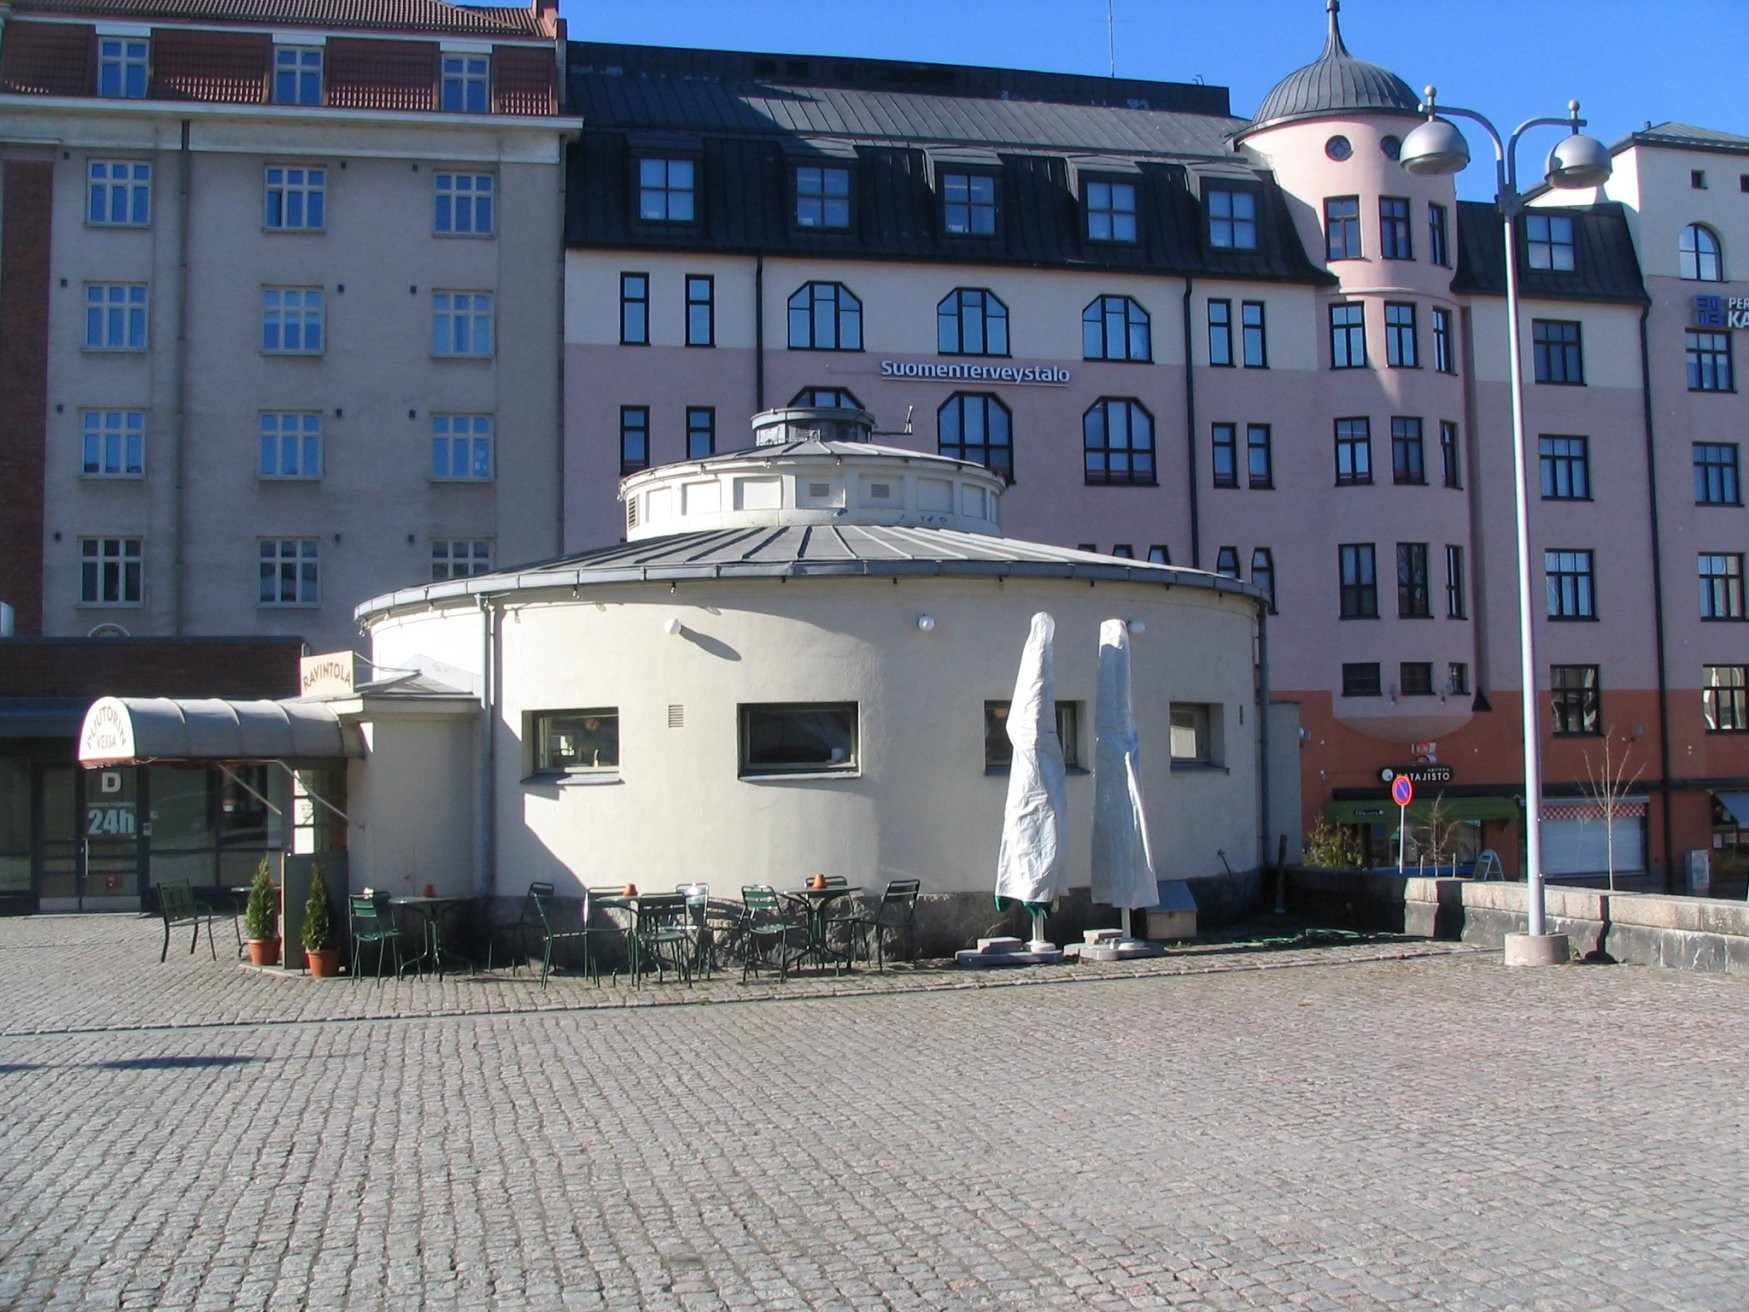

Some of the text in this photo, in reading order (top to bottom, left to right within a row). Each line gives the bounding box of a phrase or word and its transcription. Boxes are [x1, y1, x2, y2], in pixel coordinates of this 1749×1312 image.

[302, 662, 351, 691] RAVINTOLA
[96, 733, 117, 750] VESSA
[101, 772, 122, 793] D
[87, 808, 136, 835] 24h
